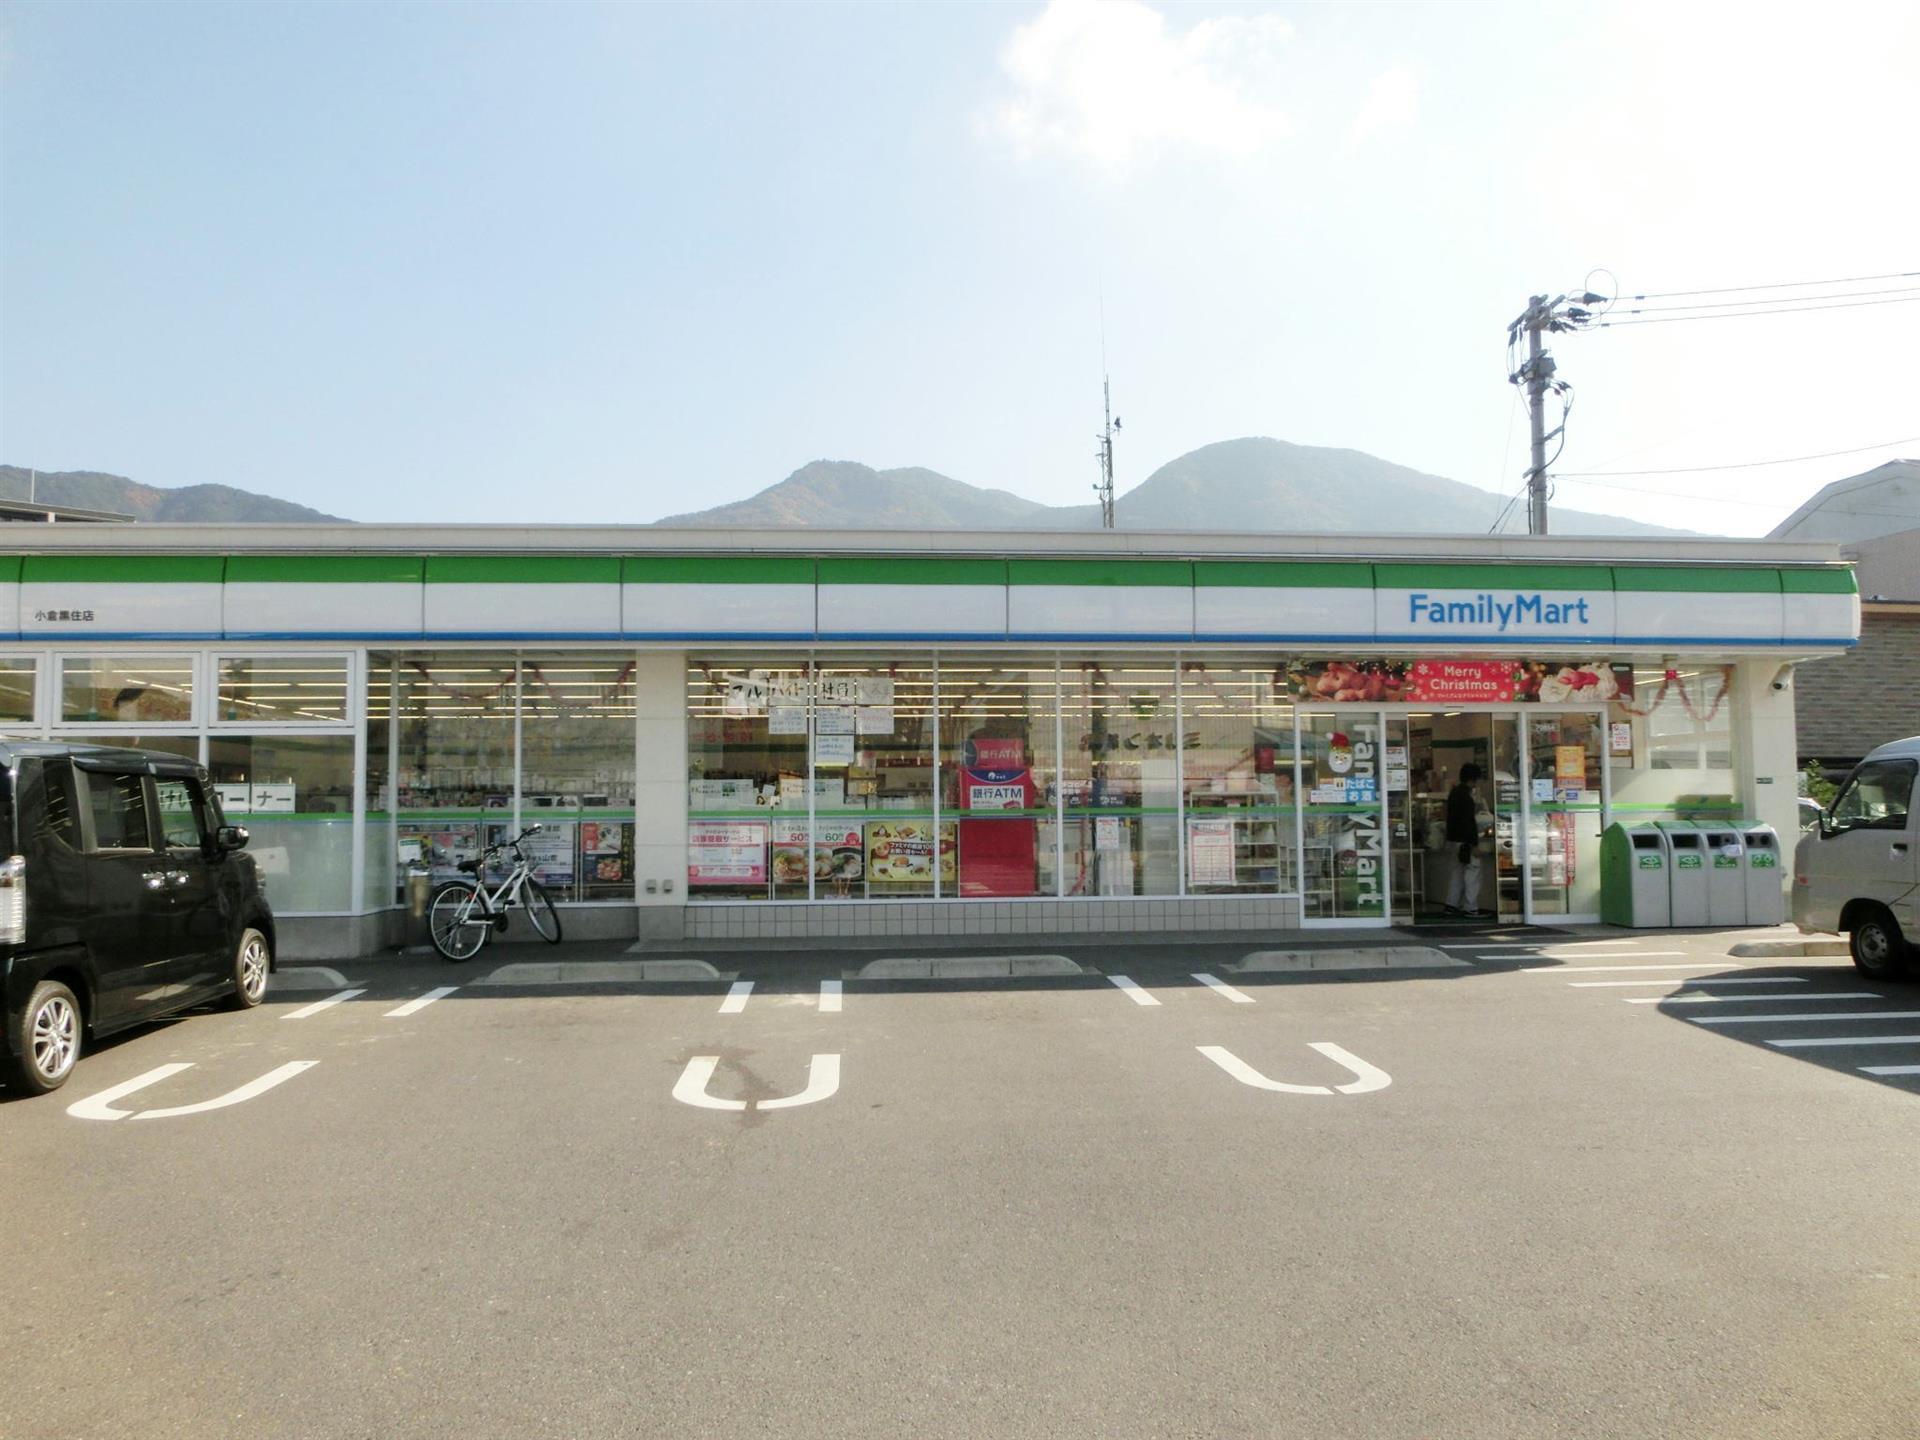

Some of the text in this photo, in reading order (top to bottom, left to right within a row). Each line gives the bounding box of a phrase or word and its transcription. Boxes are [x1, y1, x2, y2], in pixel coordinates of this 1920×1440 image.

[1409, 594, 1589, 631] FamilyMart
[1443, 665, 1482, 679] Merry
[1430, 679, 1498, 690] Christmas
[973, 788, 1022, 798] 銀行ATM
